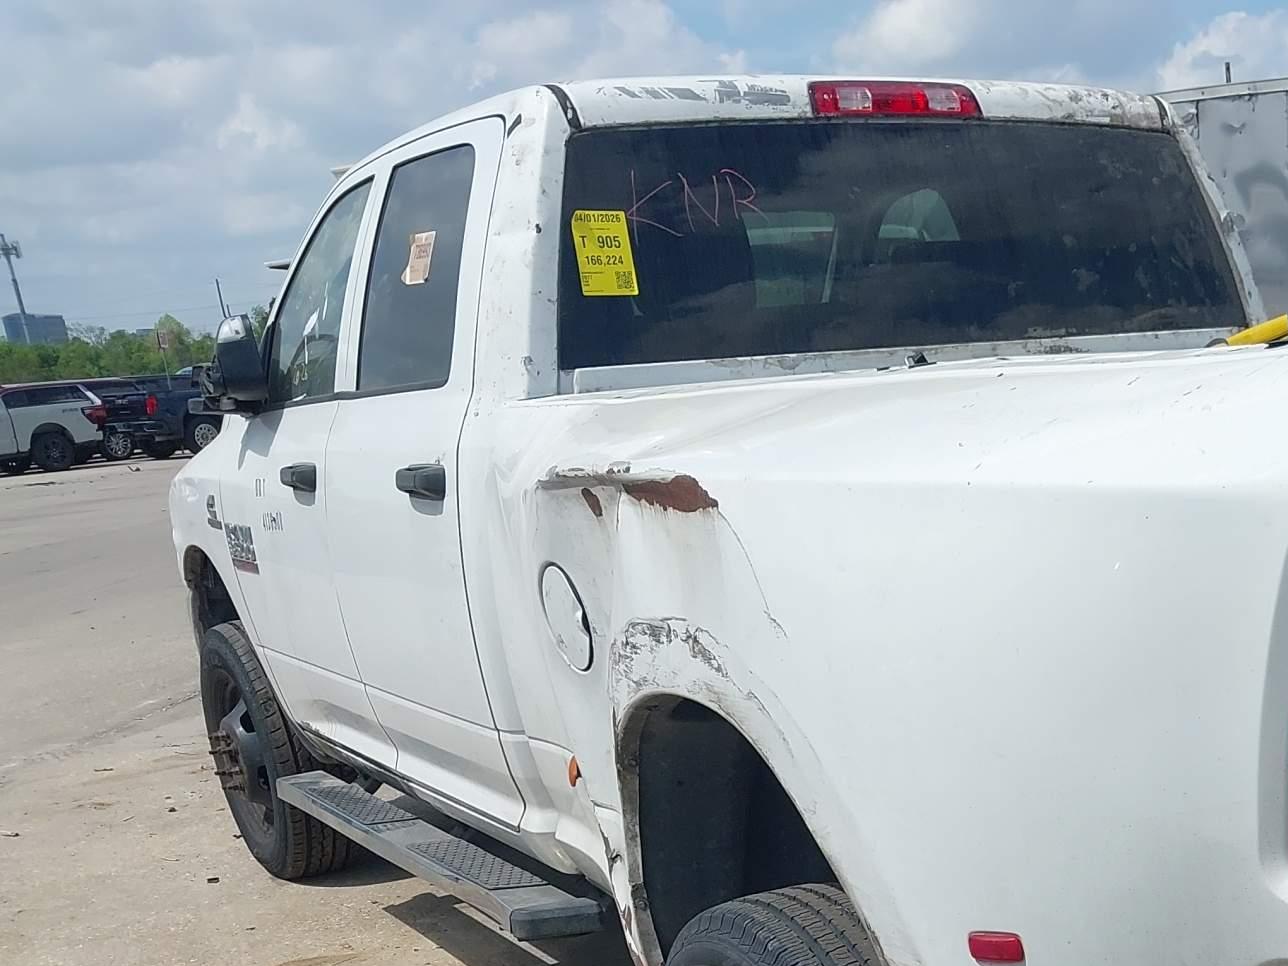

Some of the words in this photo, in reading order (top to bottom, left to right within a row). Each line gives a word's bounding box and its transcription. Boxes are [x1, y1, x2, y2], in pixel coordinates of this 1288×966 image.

[626, 168, 769, 247] KNR
[574, 212, 621, 223] 04/01/2026
[579, 235, 587, 249] T
[597, 235, 622, 249] 905
[584, 254, 624, 267] 166,224
